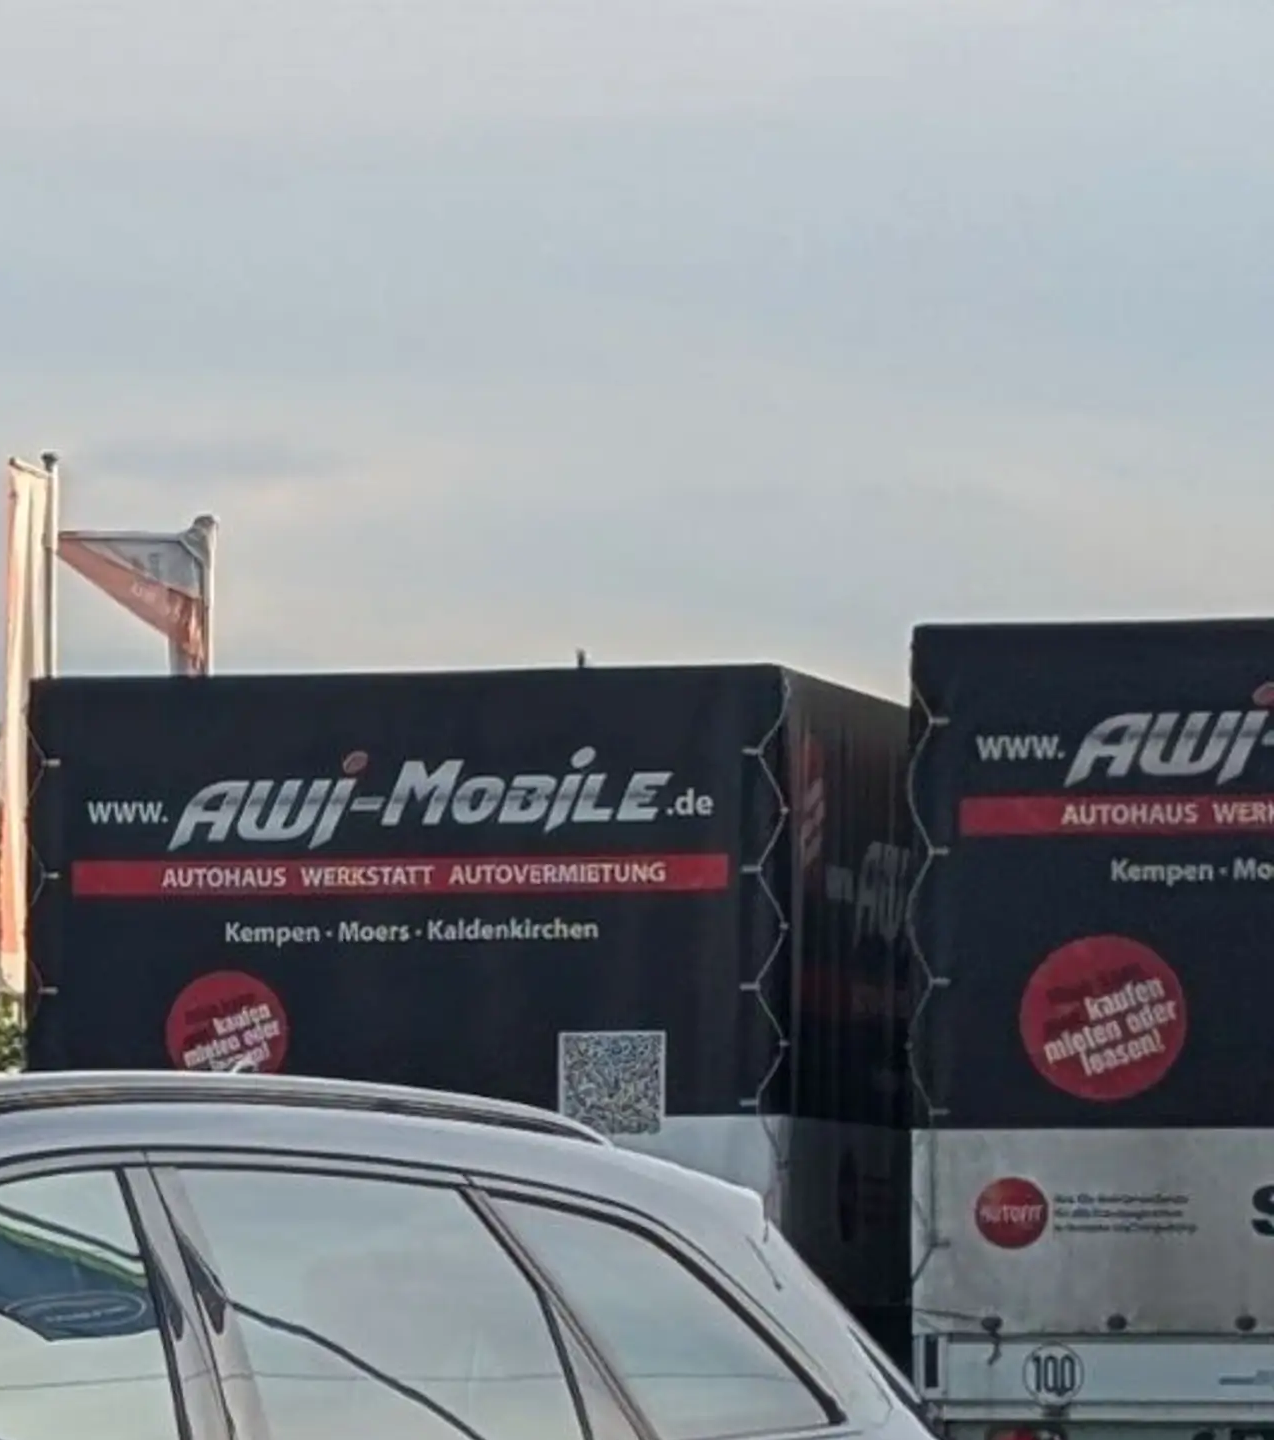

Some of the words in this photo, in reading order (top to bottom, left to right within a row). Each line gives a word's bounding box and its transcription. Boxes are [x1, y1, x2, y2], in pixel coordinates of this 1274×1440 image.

[1062, 803, 1199, 826] AUTOHAUS
[162, 866, 287, 888] AUTOHAUS
[300, 864, 435, 887] WERKSTATT
[448, 861, 667, 886] AUTOVERMIETUNG
[1111, 859, 1214, 887] Kempen
[225, 922, 321, 947] Kempen
[338, 920, 409, 944] Moers
[426, 918, 599, 943] Kaldenkirchen
[1084, 978, 1165, 1022] kaufen
[1125, 1000, 1176, 1034] oder
[1032, 1354, 1076, 1394] 100
